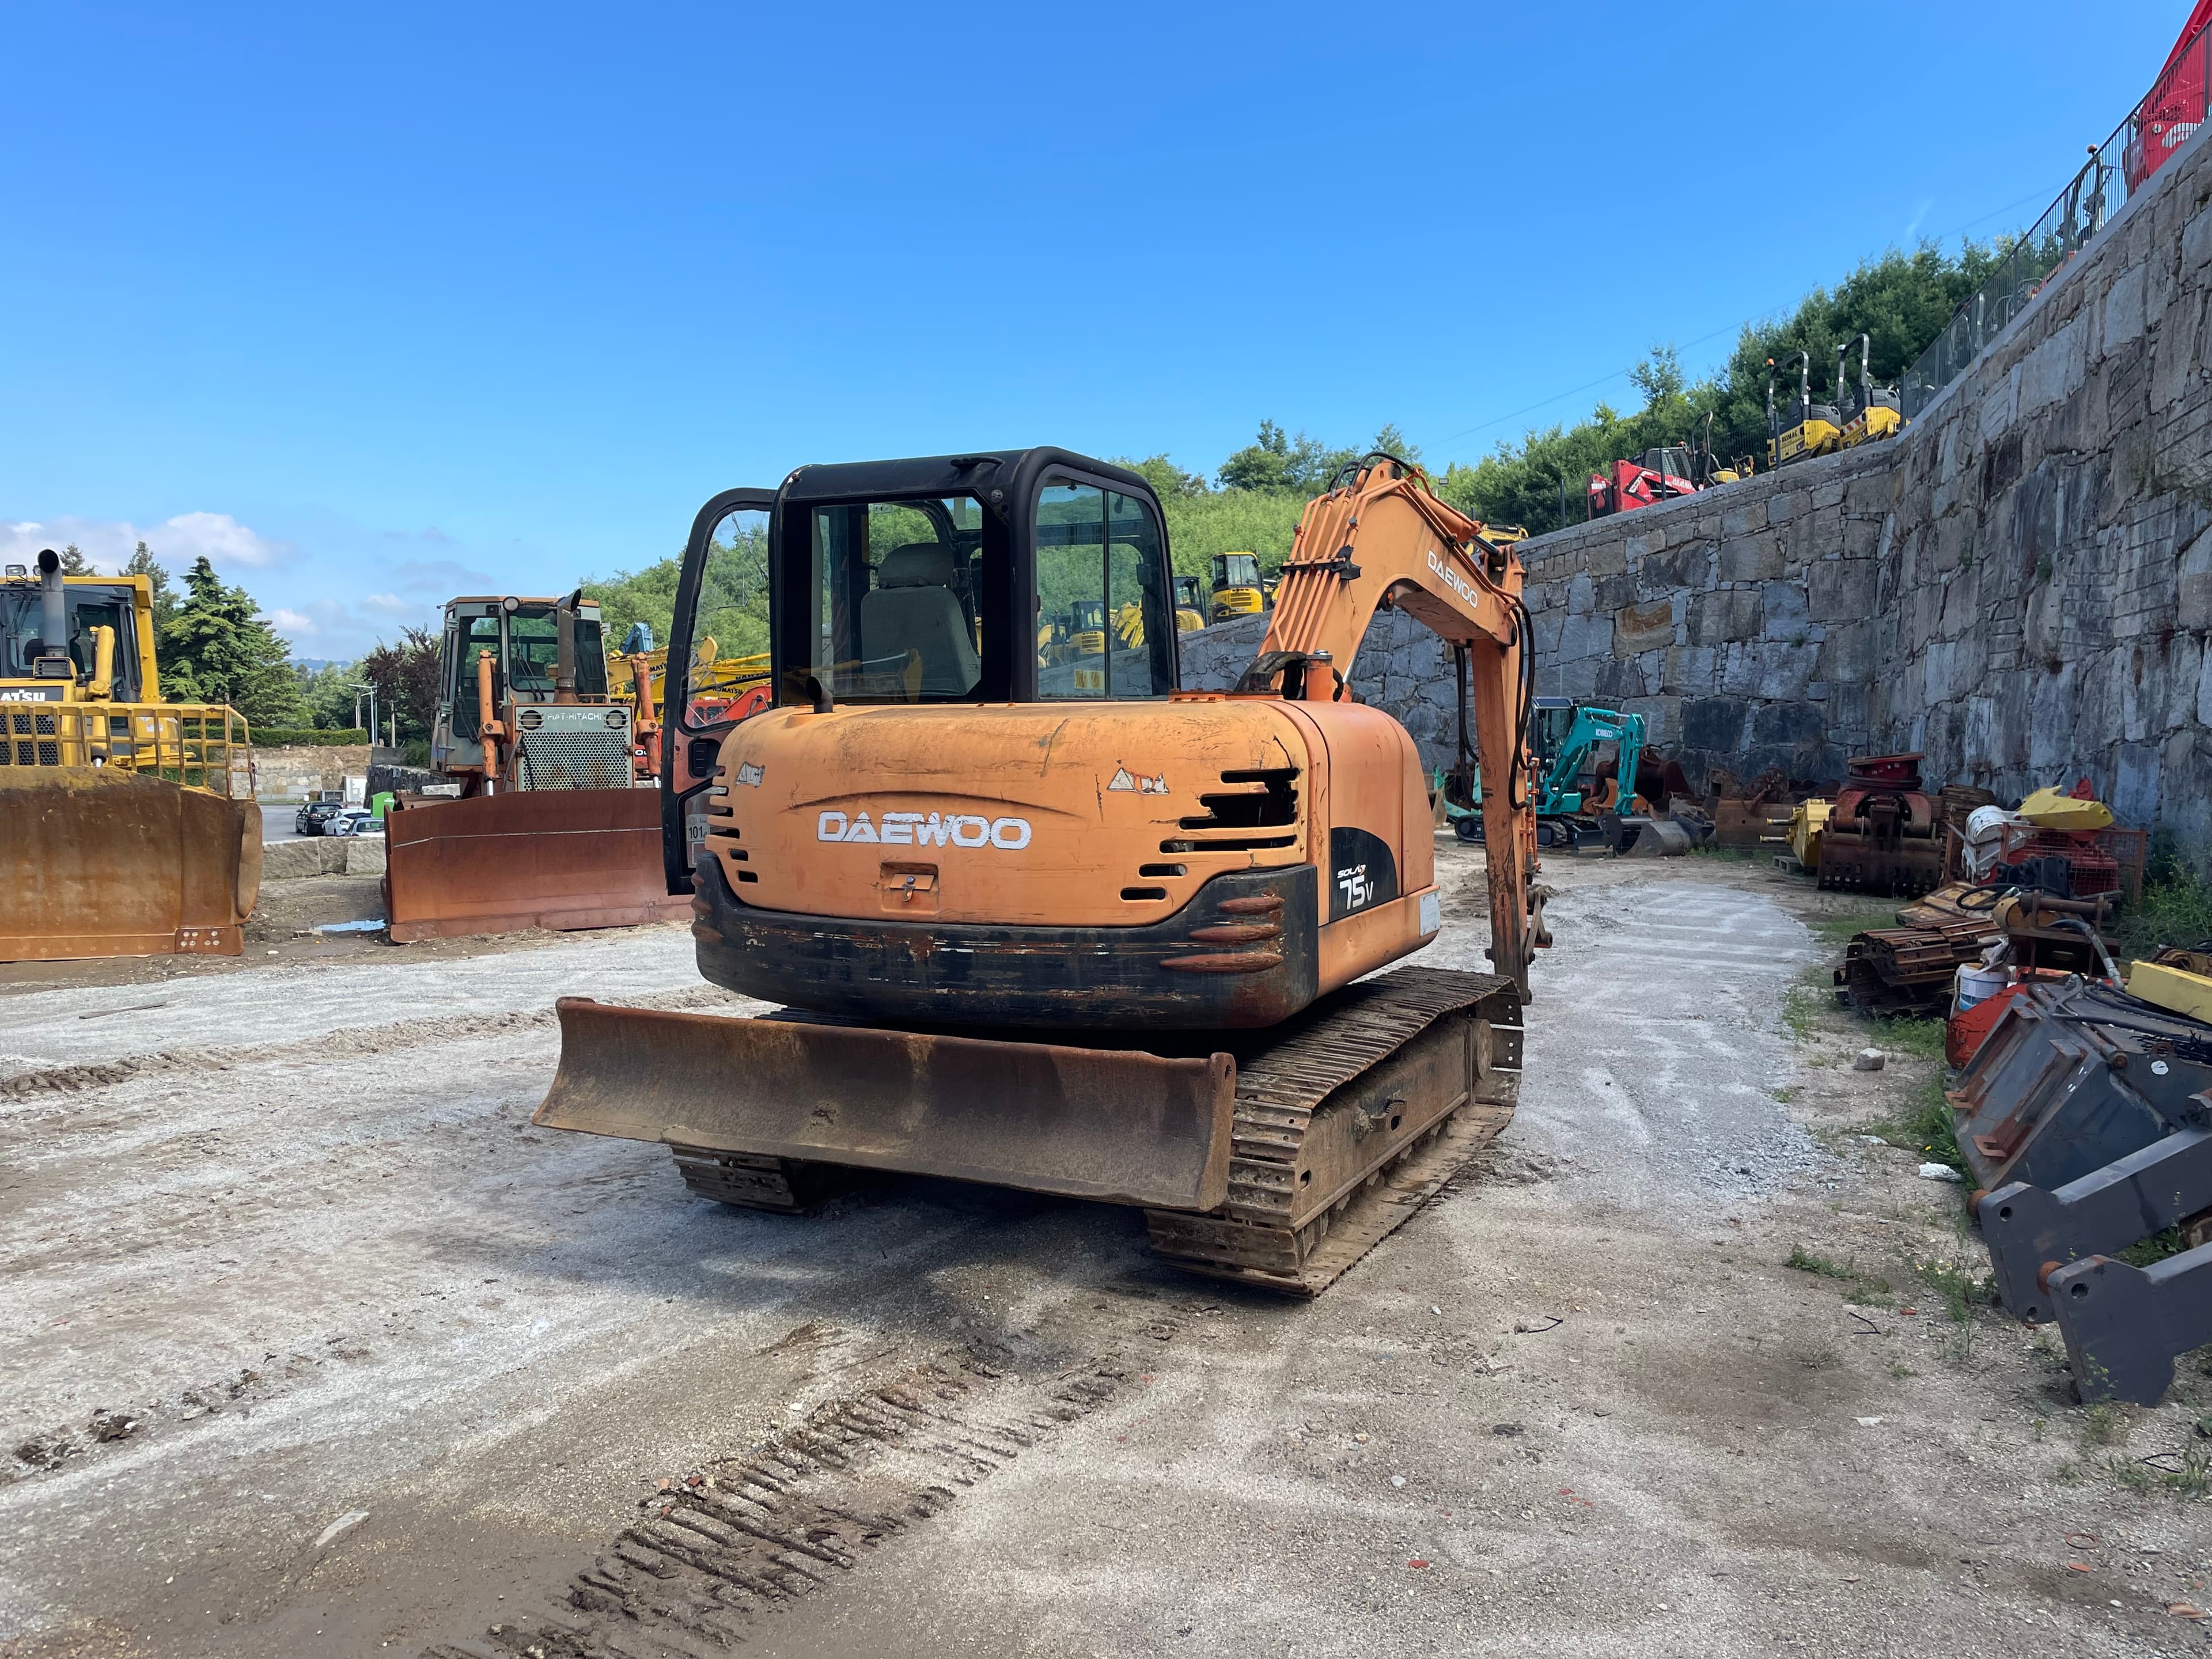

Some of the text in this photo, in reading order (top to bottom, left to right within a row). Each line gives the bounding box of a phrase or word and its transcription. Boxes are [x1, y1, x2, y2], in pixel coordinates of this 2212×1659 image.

[1427, 550, 1478, 609] DAEWOO
[817, 810, 1032, 850] DAEWOO
[1337, 864, 1366, 878] SOLAR
